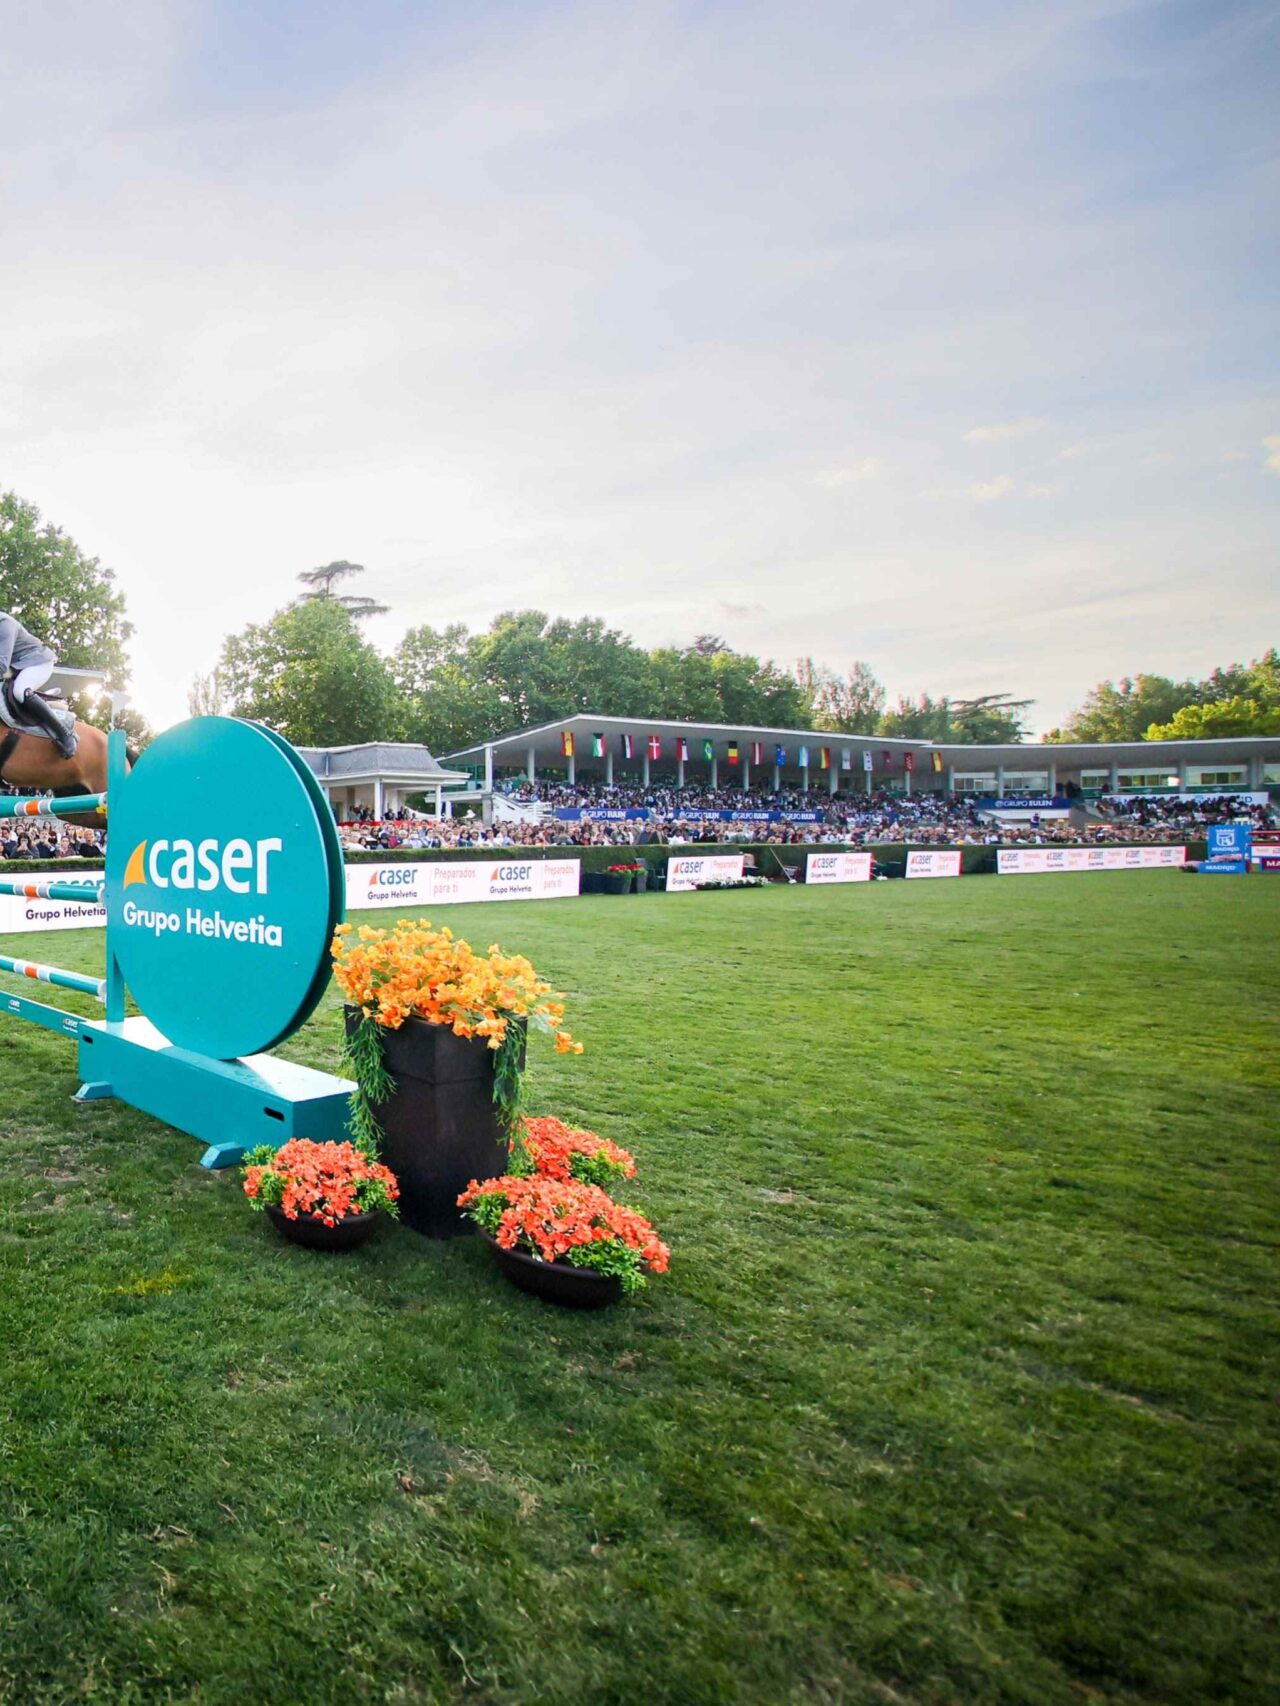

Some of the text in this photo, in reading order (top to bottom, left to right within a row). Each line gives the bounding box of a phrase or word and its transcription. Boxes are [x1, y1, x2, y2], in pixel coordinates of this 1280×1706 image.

[149, 838, 282, 894] caser
[680, 861, 704, 873] caser
[817, 857, 838, 868] caser
[379, 868, 418, 885] caser
[434, 868, 476, 880] Preparados
[500, 866, 532, 880] caser
[368, 889, 418, 901] Grupo Helvetia
[489, 885, 532, 894] Grupo Helvetia
[25, 906, 106, 922] Grupo Helvetia
[123, 901, 283, 947] Grupo Helvetia
